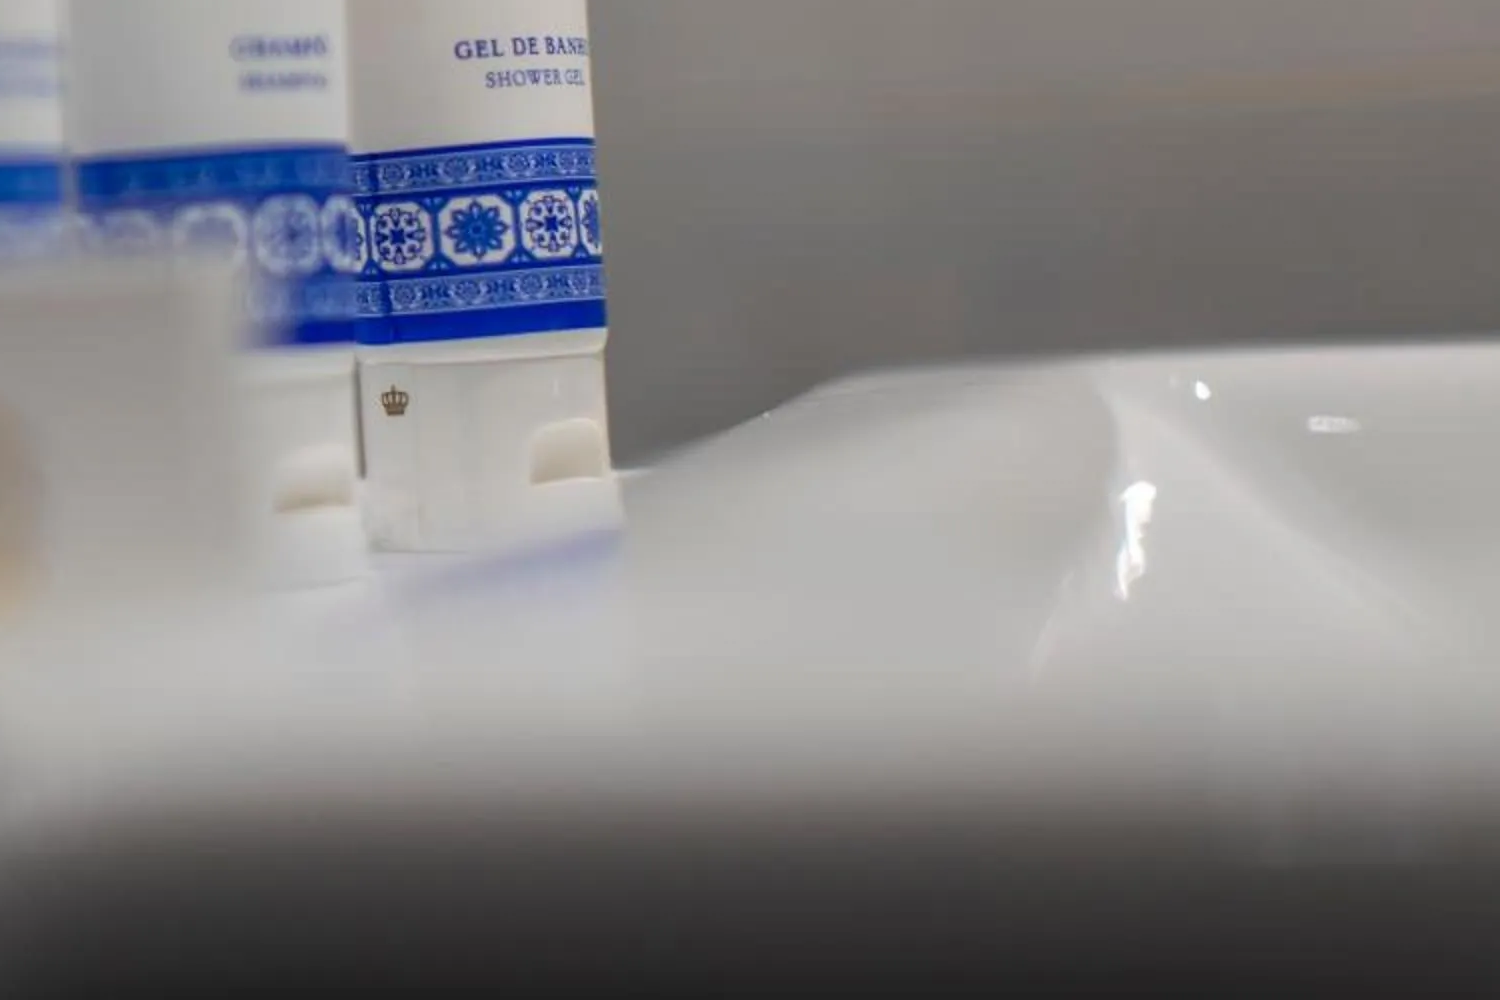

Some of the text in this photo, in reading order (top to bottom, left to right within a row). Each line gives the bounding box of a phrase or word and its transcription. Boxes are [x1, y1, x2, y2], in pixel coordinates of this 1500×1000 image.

[453, 39, 504, 61] GEL
[511, 36, 539, 56] DE
[485, 68, 586, 89] SHOWER GEL
